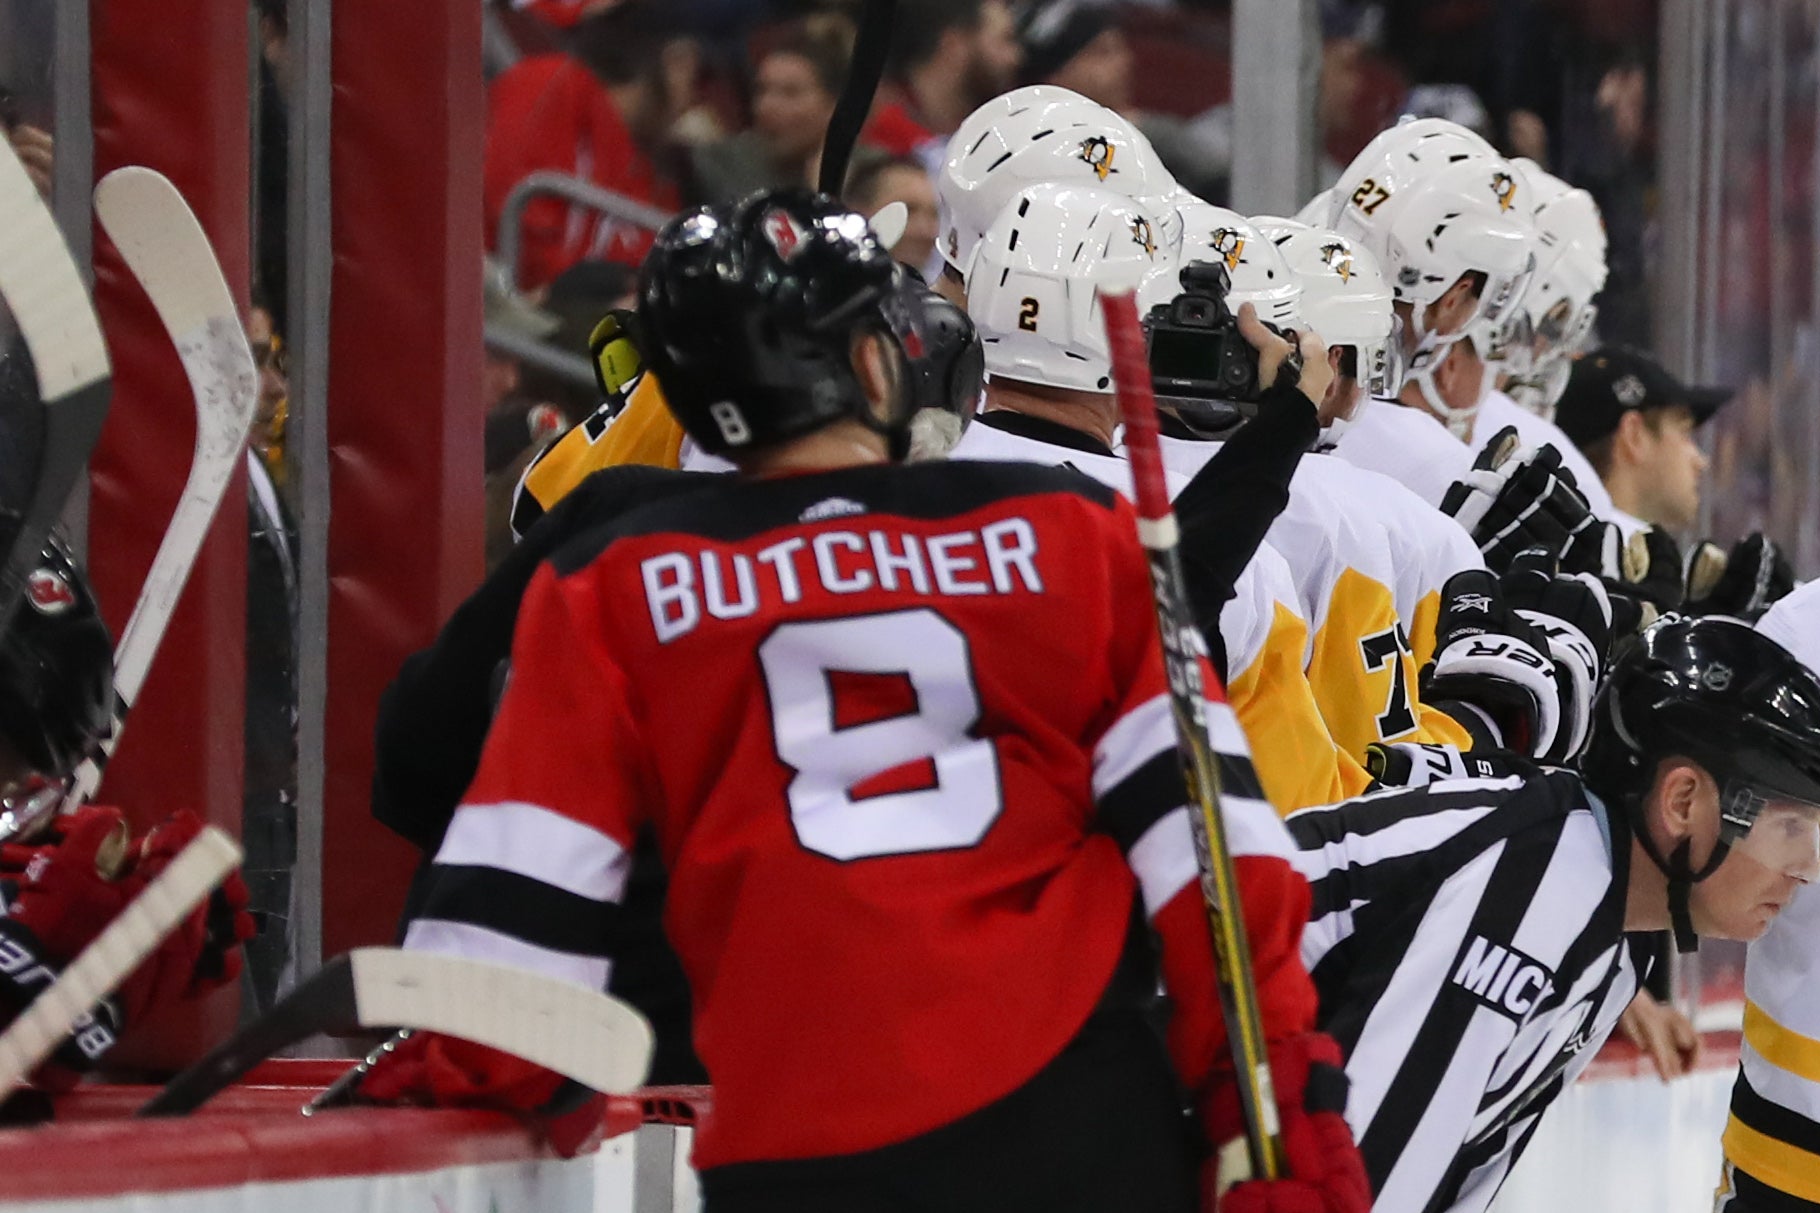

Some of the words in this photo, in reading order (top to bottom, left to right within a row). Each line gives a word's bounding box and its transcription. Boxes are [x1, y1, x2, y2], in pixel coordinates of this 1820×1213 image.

[1352, 178, 1391, 216] 27
[1018, 296, 1039, 332] 2
[709, 400, 752, 447] 8
[640, 516, 1045, 646] BUTCHER
[756, 605, 1006, 864] 8
[1452, 934, 1556, 1016] MIC
